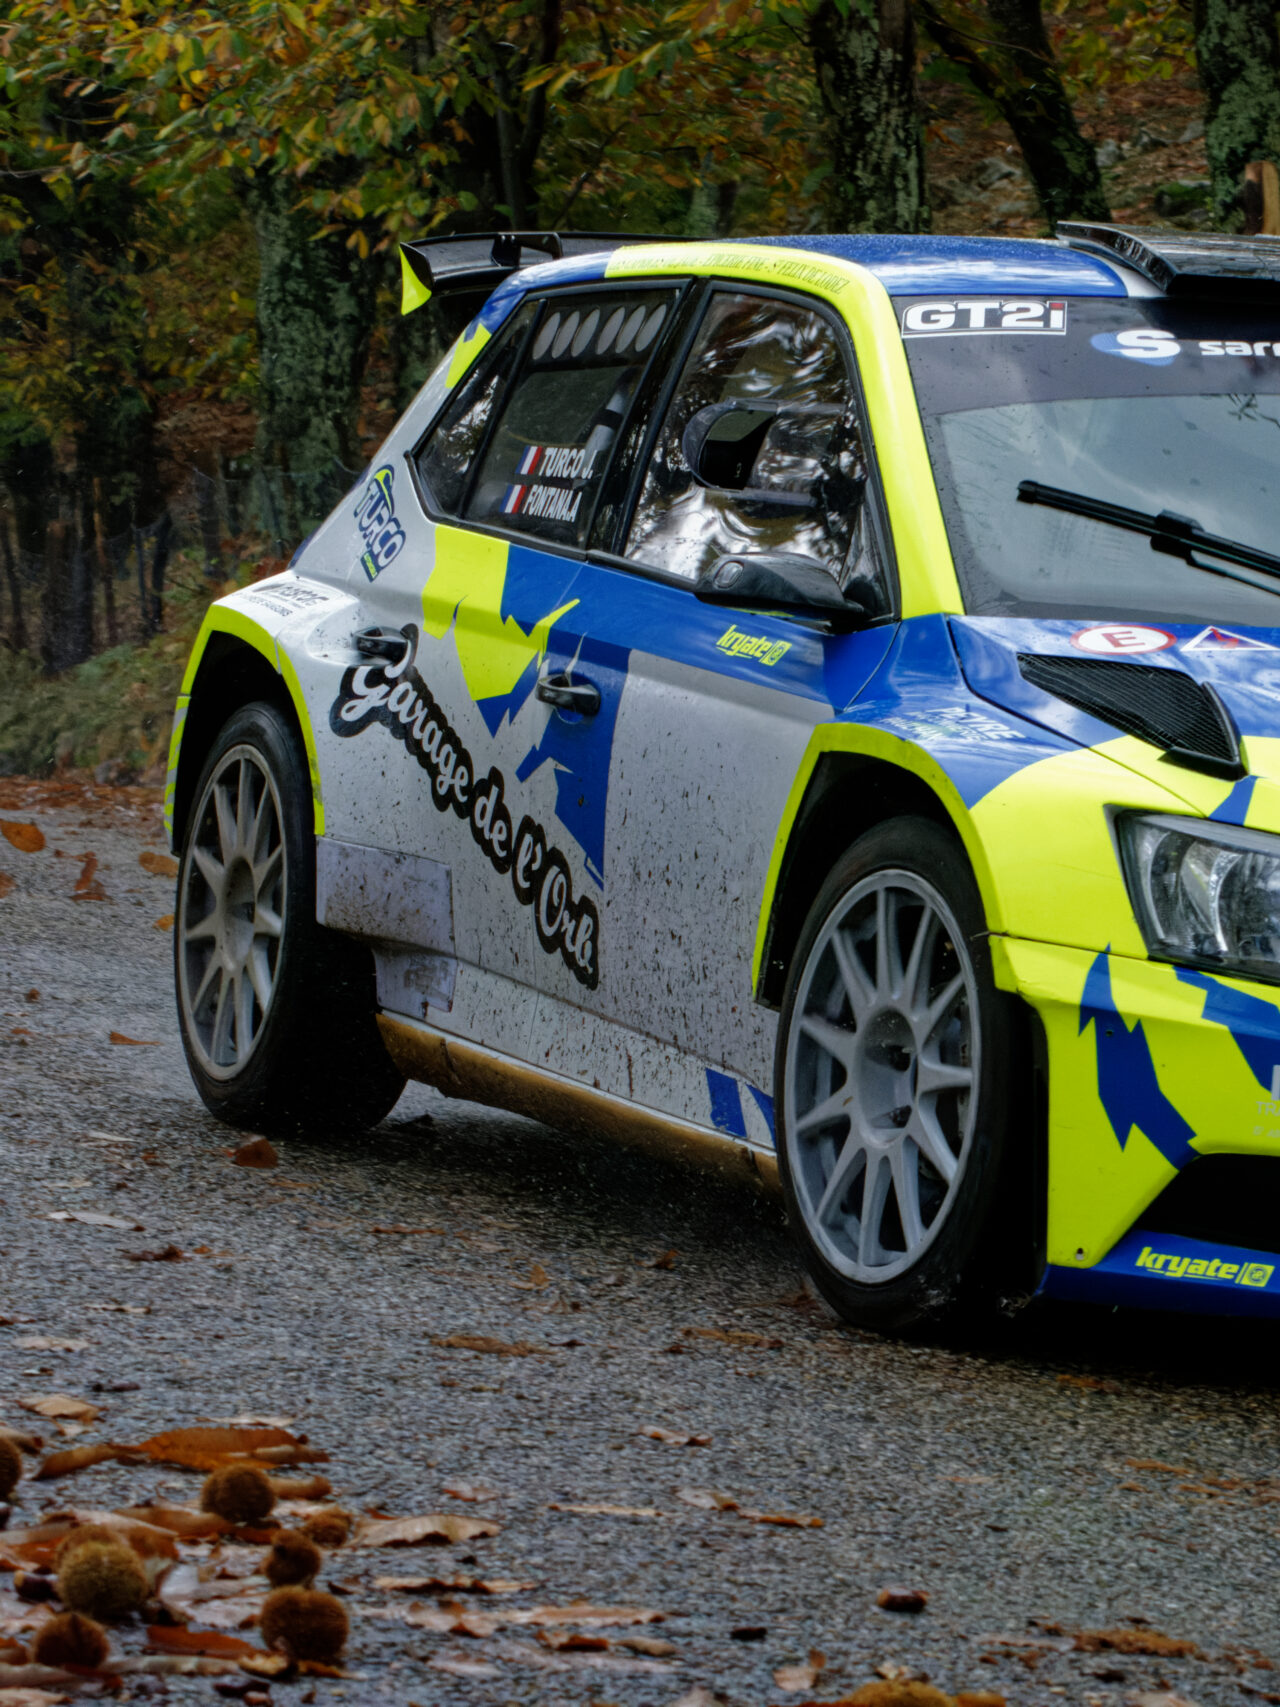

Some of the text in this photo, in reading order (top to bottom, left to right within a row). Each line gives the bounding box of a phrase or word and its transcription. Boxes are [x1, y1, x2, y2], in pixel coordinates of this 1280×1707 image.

[905, 301, 1065, 331] GT2i
[539, 447, 598, 480] TURCO J.
[353, 477, 404, 569] TURCO
[1101, 631, 1146, 649] E
[341, 640, 470, 804] Garage
[475, 784, 509, 858] de
[1135, 1246, 1240, 1281] kryate
